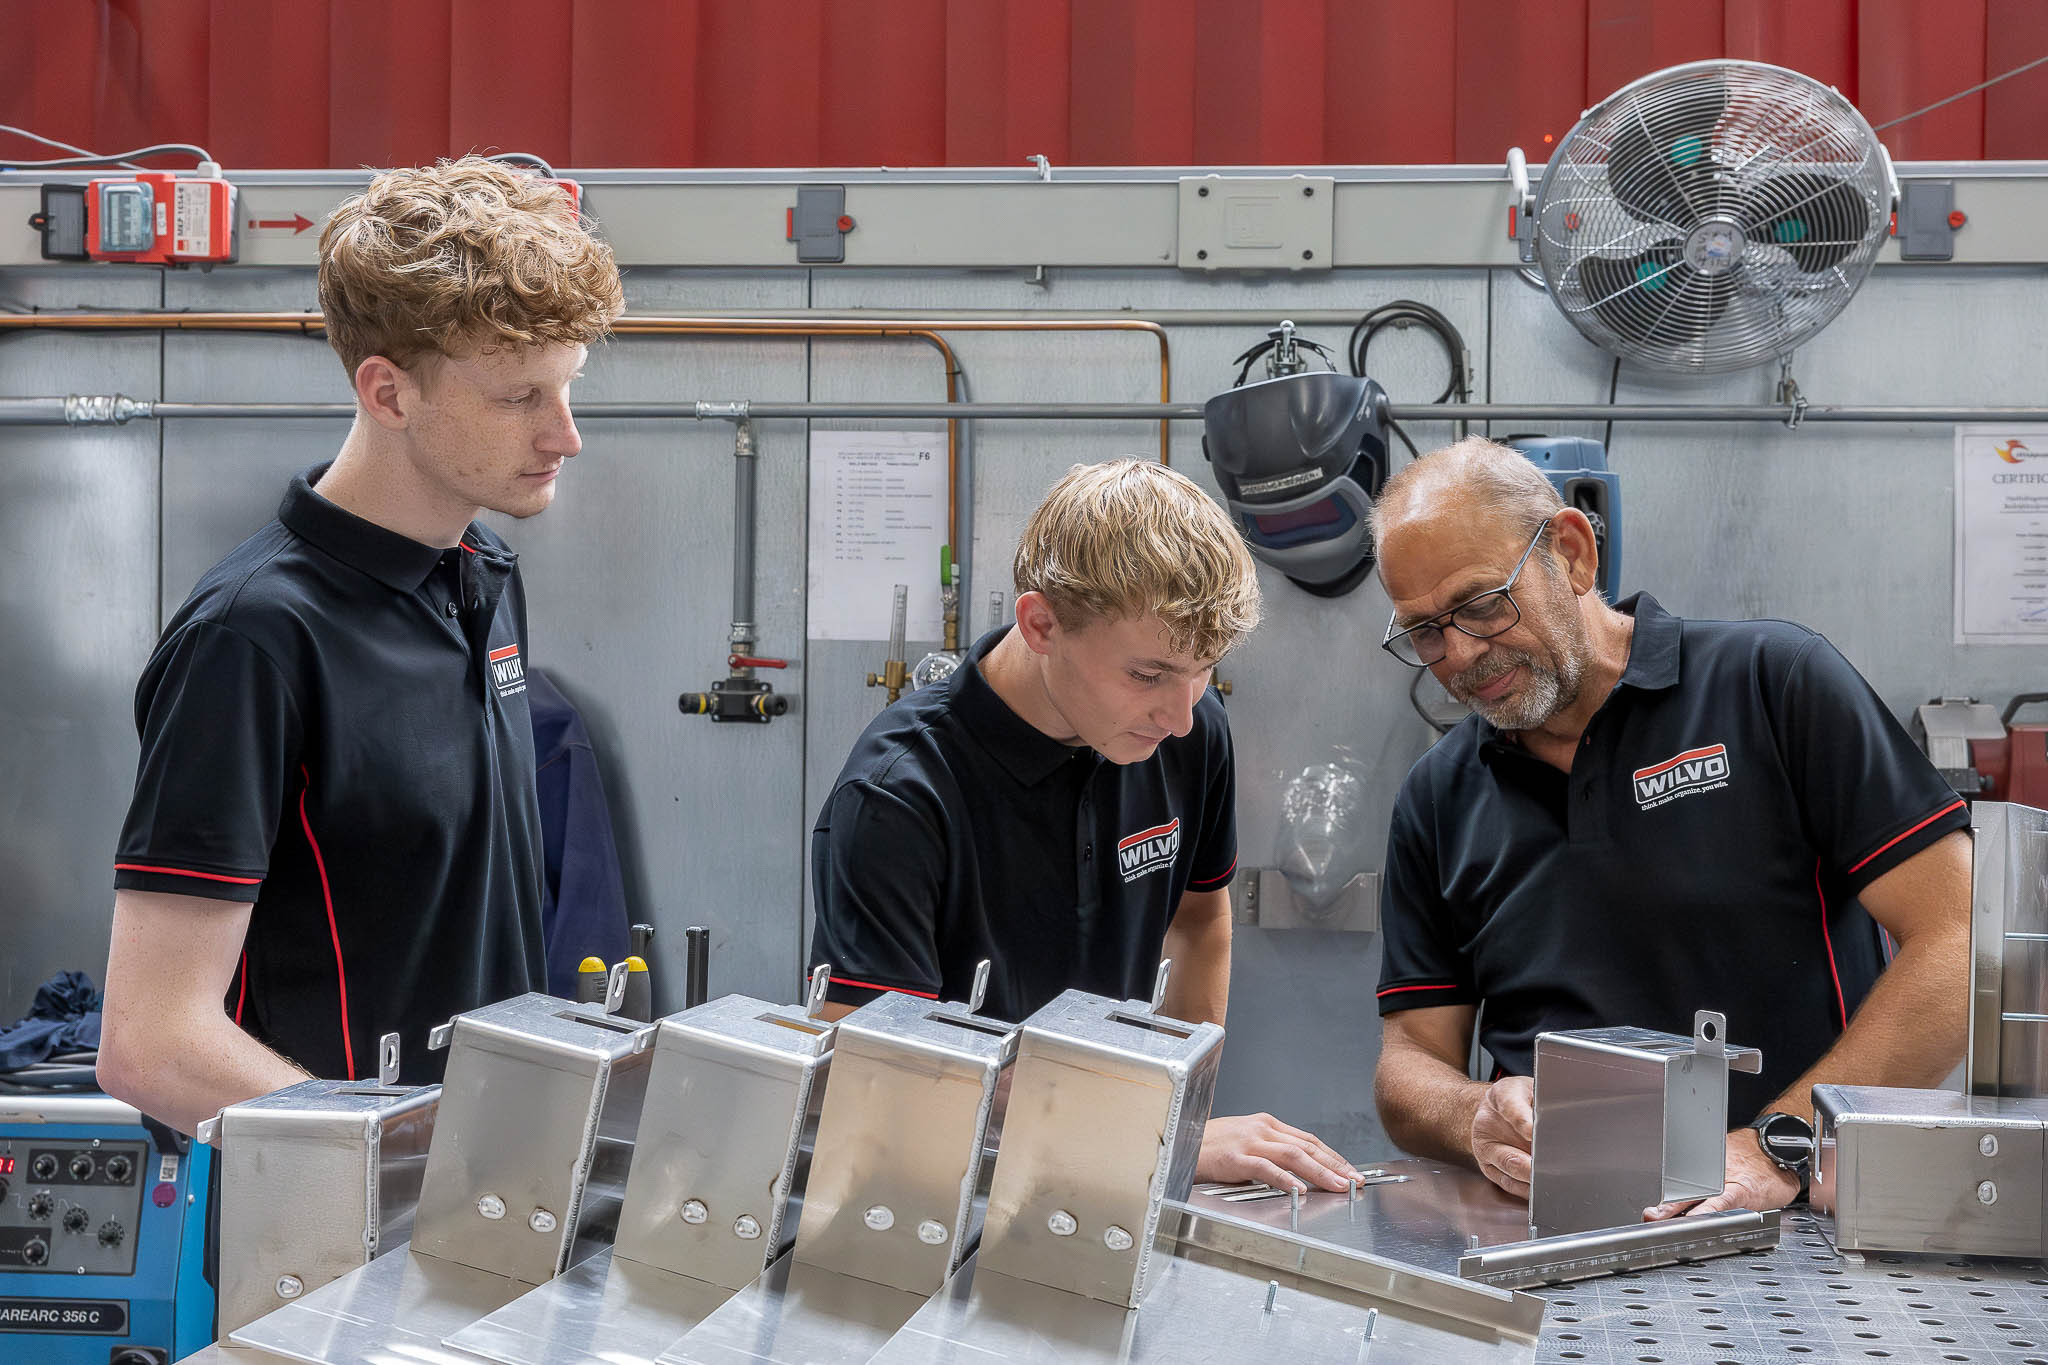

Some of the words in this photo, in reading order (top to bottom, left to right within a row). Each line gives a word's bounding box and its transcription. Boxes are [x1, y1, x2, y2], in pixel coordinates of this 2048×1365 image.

[919, 451, 931, 461] F6
[1638, 756, 1725, 798] WILVO
[1120, 830, 1178, 870] WILVO
[0, 1308, 60, 1322] AREARC
[62, 1309, 87, 1323] 356
[89, 1311, 100, 1324] C
